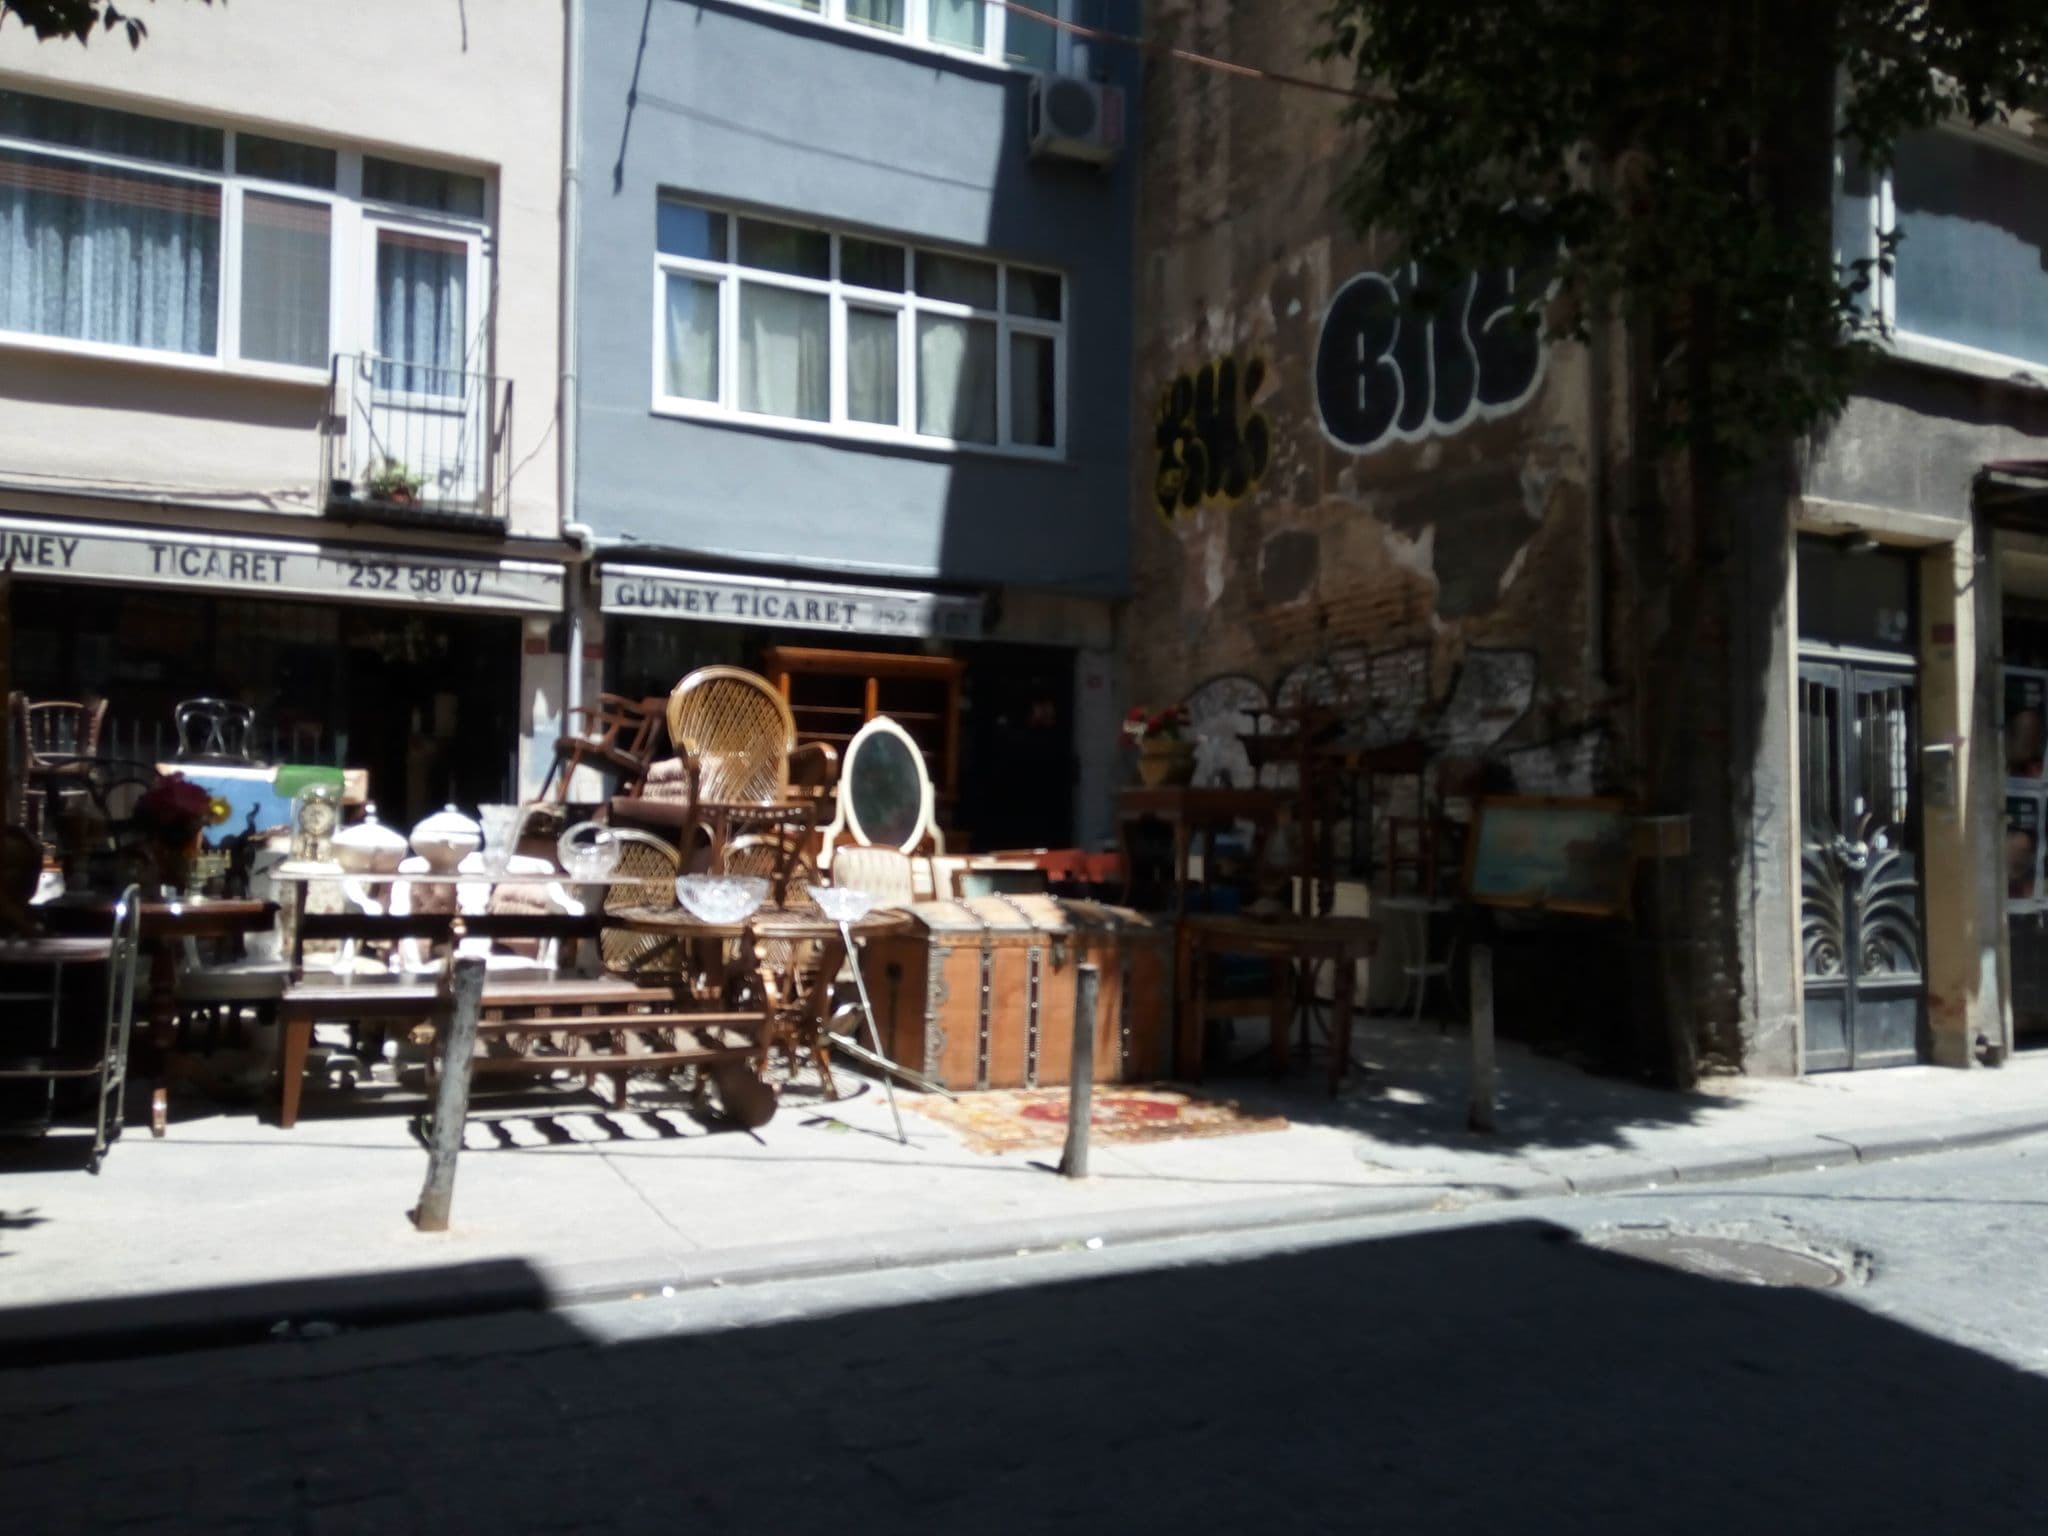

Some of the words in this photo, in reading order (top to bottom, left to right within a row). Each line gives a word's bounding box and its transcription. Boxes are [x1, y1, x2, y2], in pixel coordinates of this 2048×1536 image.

[348, 559, 398, 590] 252
[408, 566, 442, 593] 58
[452, 567, 483, 595] 07
[615, 577, 719, 612] GÜNEY
